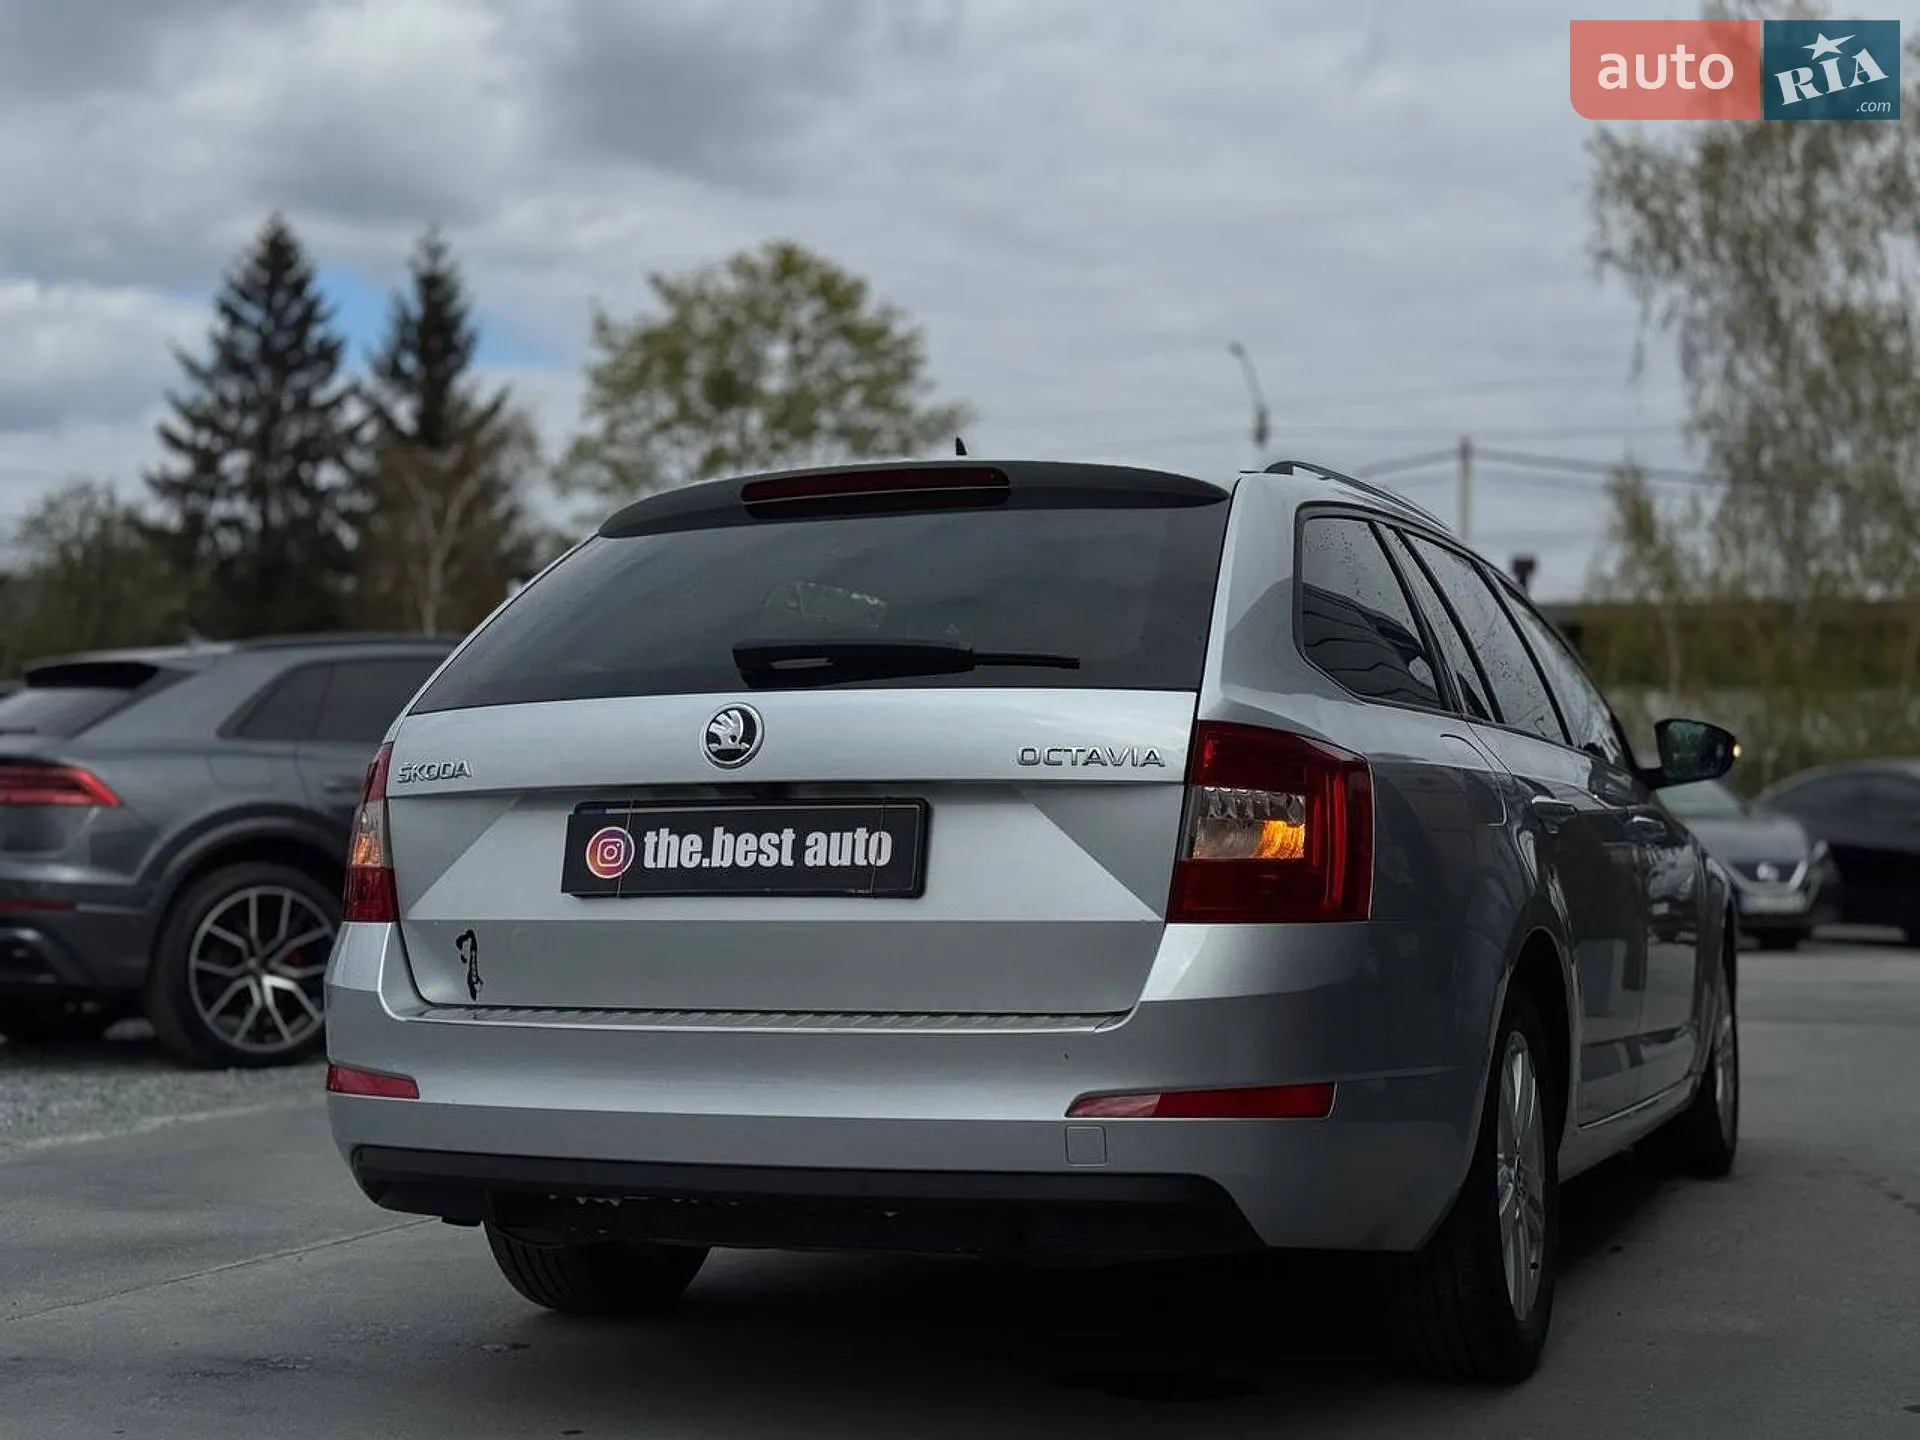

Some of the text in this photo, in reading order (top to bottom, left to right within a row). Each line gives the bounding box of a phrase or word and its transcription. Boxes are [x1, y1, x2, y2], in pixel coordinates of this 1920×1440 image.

[1017, 746, 1165, 767] OCTAVIA
[643, 826, 893, 869] the.best auto
